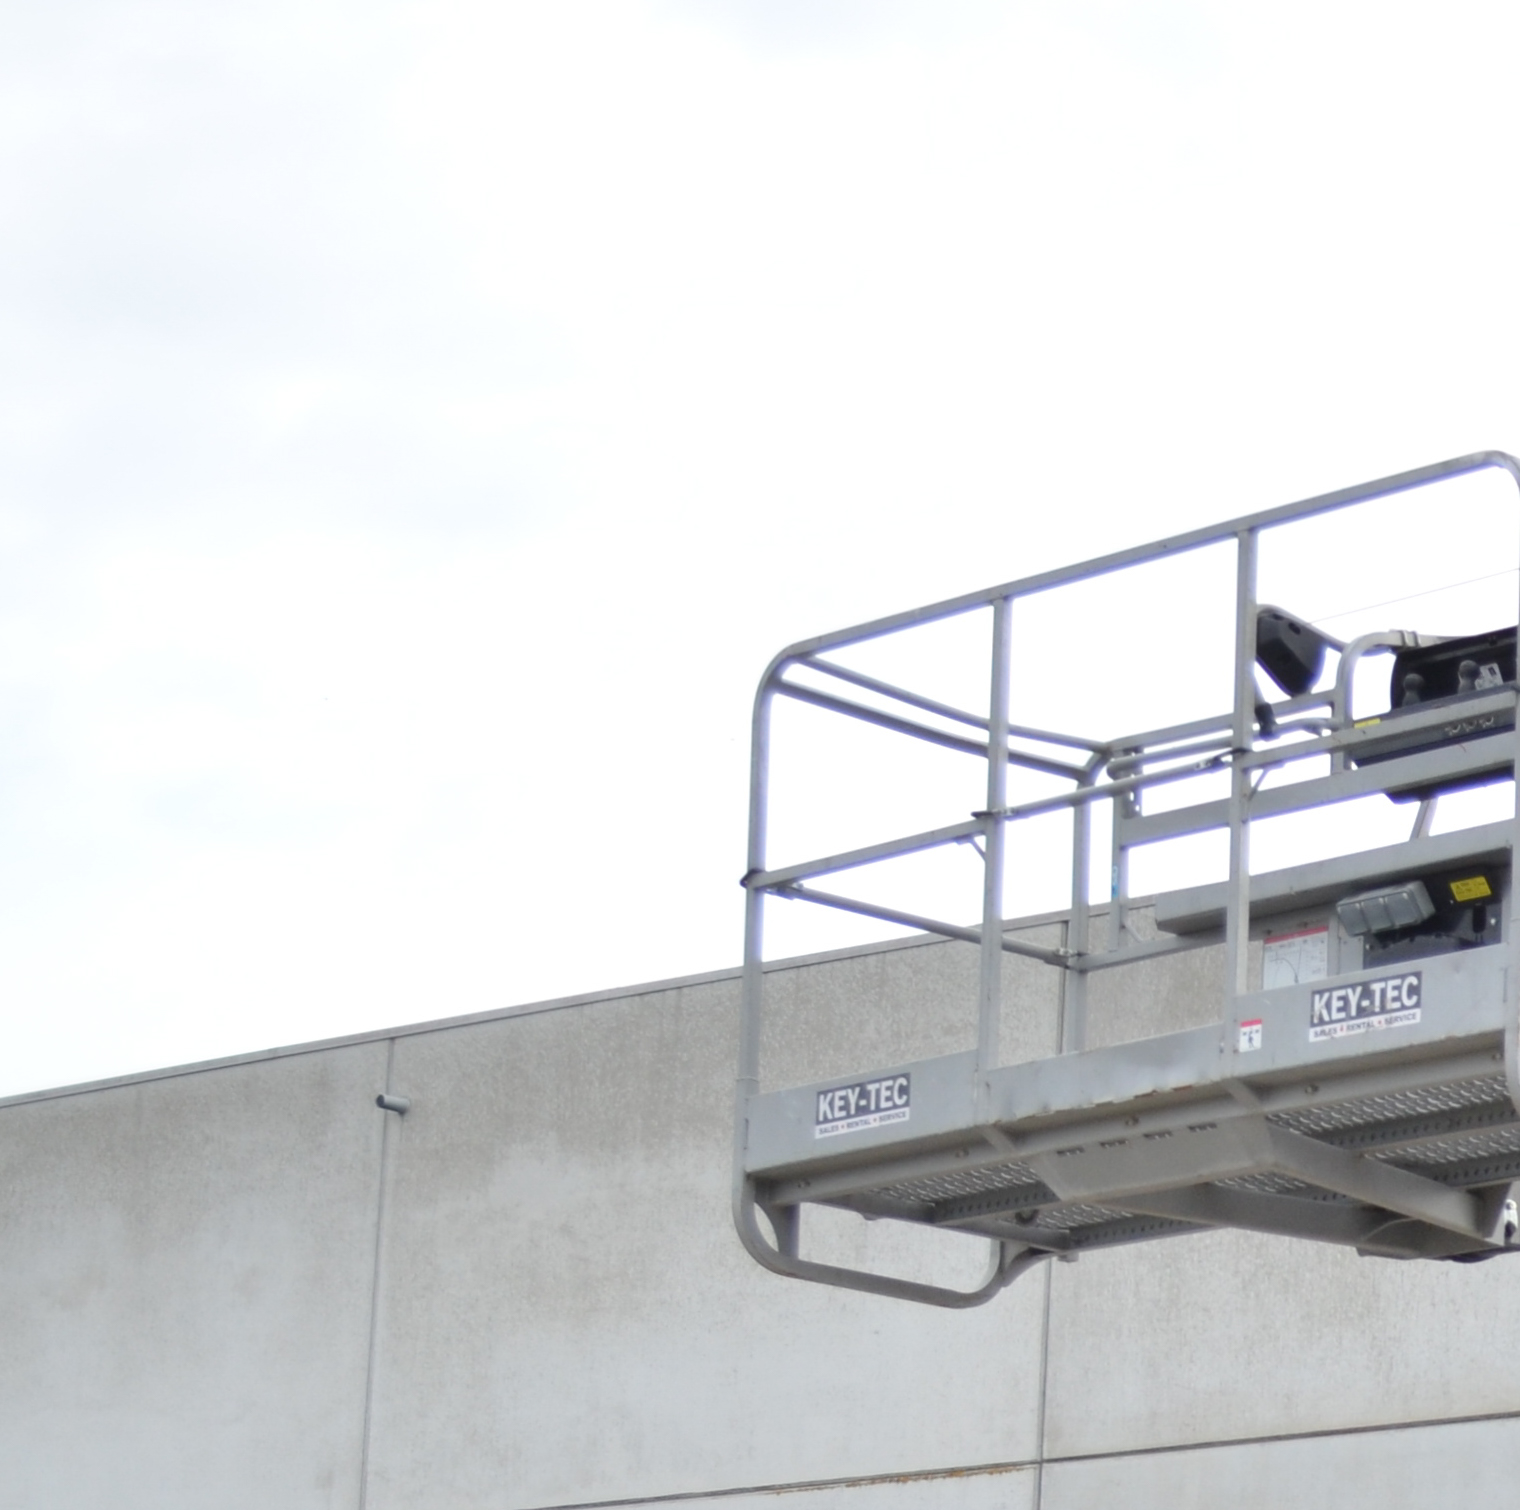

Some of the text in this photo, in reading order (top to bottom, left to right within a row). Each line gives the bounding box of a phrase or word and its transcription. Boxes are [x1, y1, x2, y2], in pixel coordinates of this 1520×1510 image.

[1312, 975, 1419, 1024] KEY-TEC
[1313, 1012, 1417, 1038] SALES RENTAL SERVICE
[818, 1077, 908, 1122] KEY-TEC
